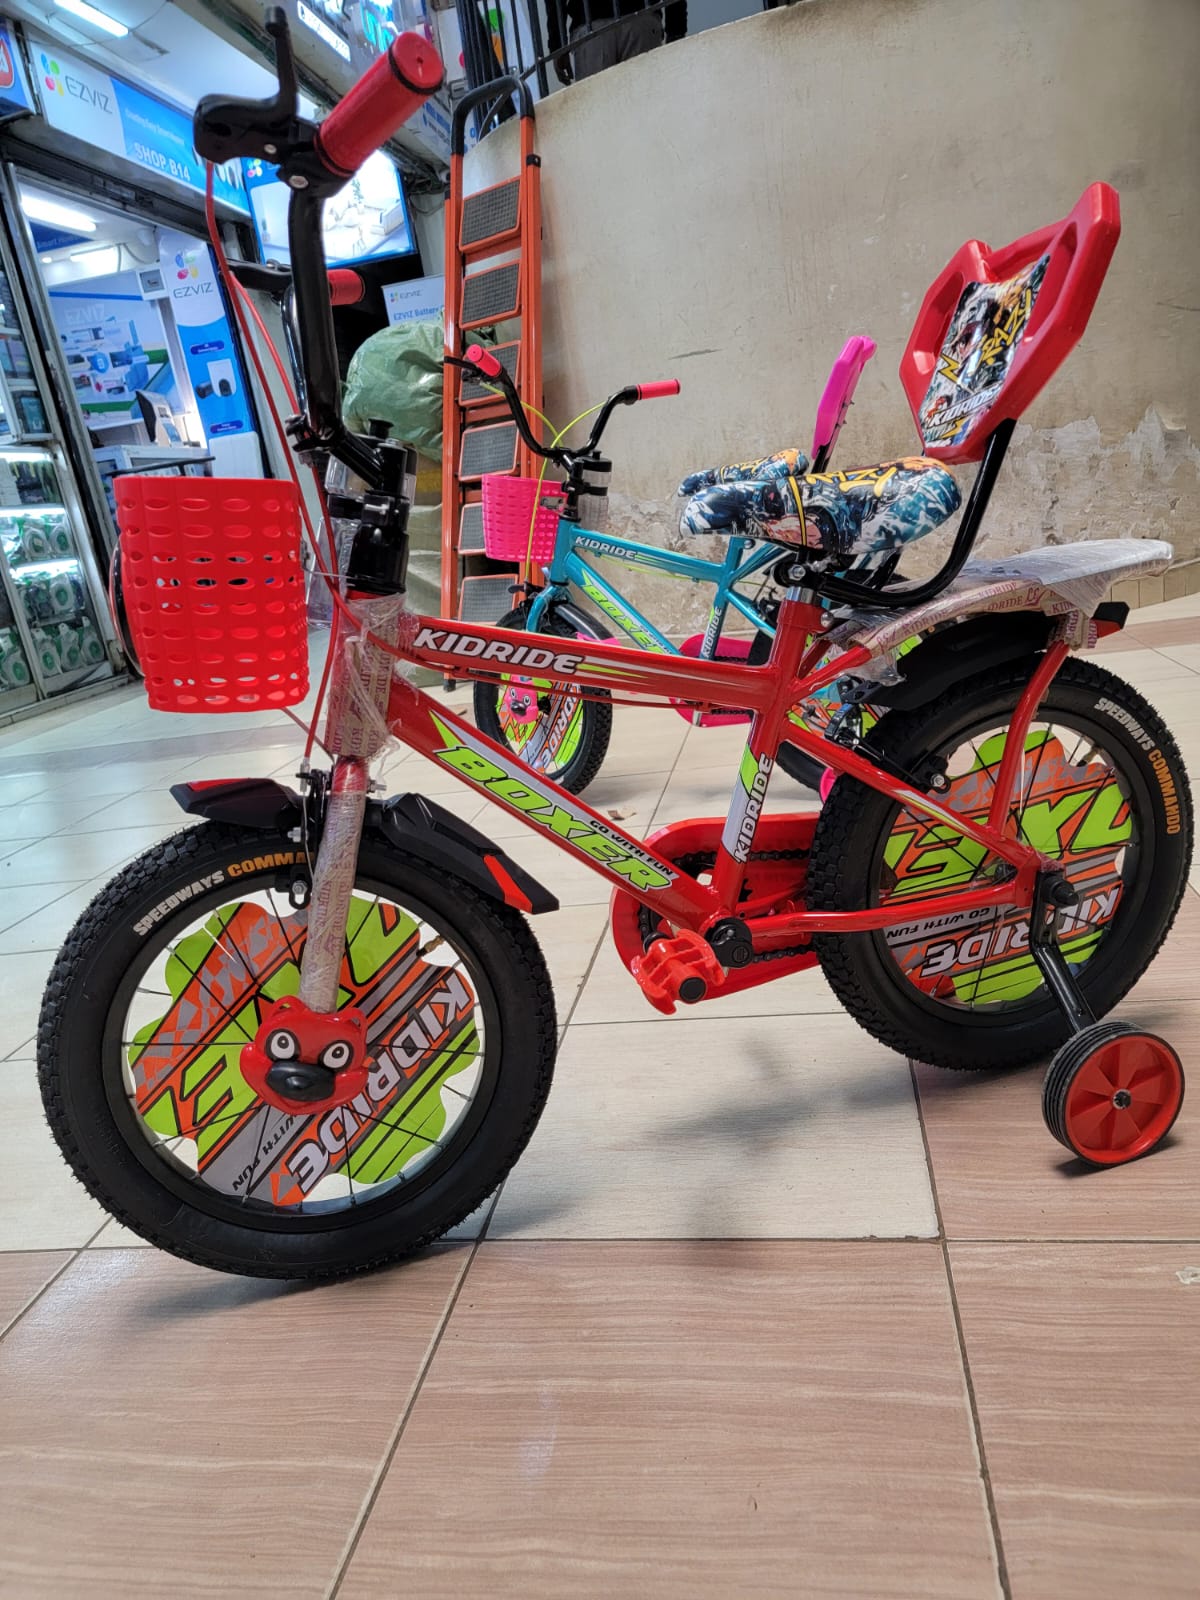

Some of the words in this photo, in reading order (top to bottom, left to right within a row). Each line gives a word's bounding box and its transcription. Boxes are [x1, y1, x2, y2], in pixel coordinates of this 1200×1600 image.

[65, 76, 113, 114] EZVIZ
[133, 142, 167, 169] SHOP
[168, 158, 191, 181] B14
[173, 282, 214, 299] EZVIZ
[575, 536, 637, 560] KIDRIDE
[411, 627, 585, 675] KIDRIDE
[702, 606, 723, 659] KIDRIDE
[1094, 697, 1156, 751] SPEEDWAYS
[733, 752, 773, 864] KIDRIDE
[1148, 748, 1181, 835] COMMANDO
[434, 745, 672, 890] BOXER
[590, 819, 610, 835] GO
[611, 834, 645, 858] WITH
[646, 856, 674, 877] FUN
[132, 870, 225, 936] SPEEDWAYS
[923, 914, 965, 931] WITH
[968, 907, 991, 920] GO
[886, 925, 919, 939] FUN
[286, 970, 473, 1195] KIDRIDE
